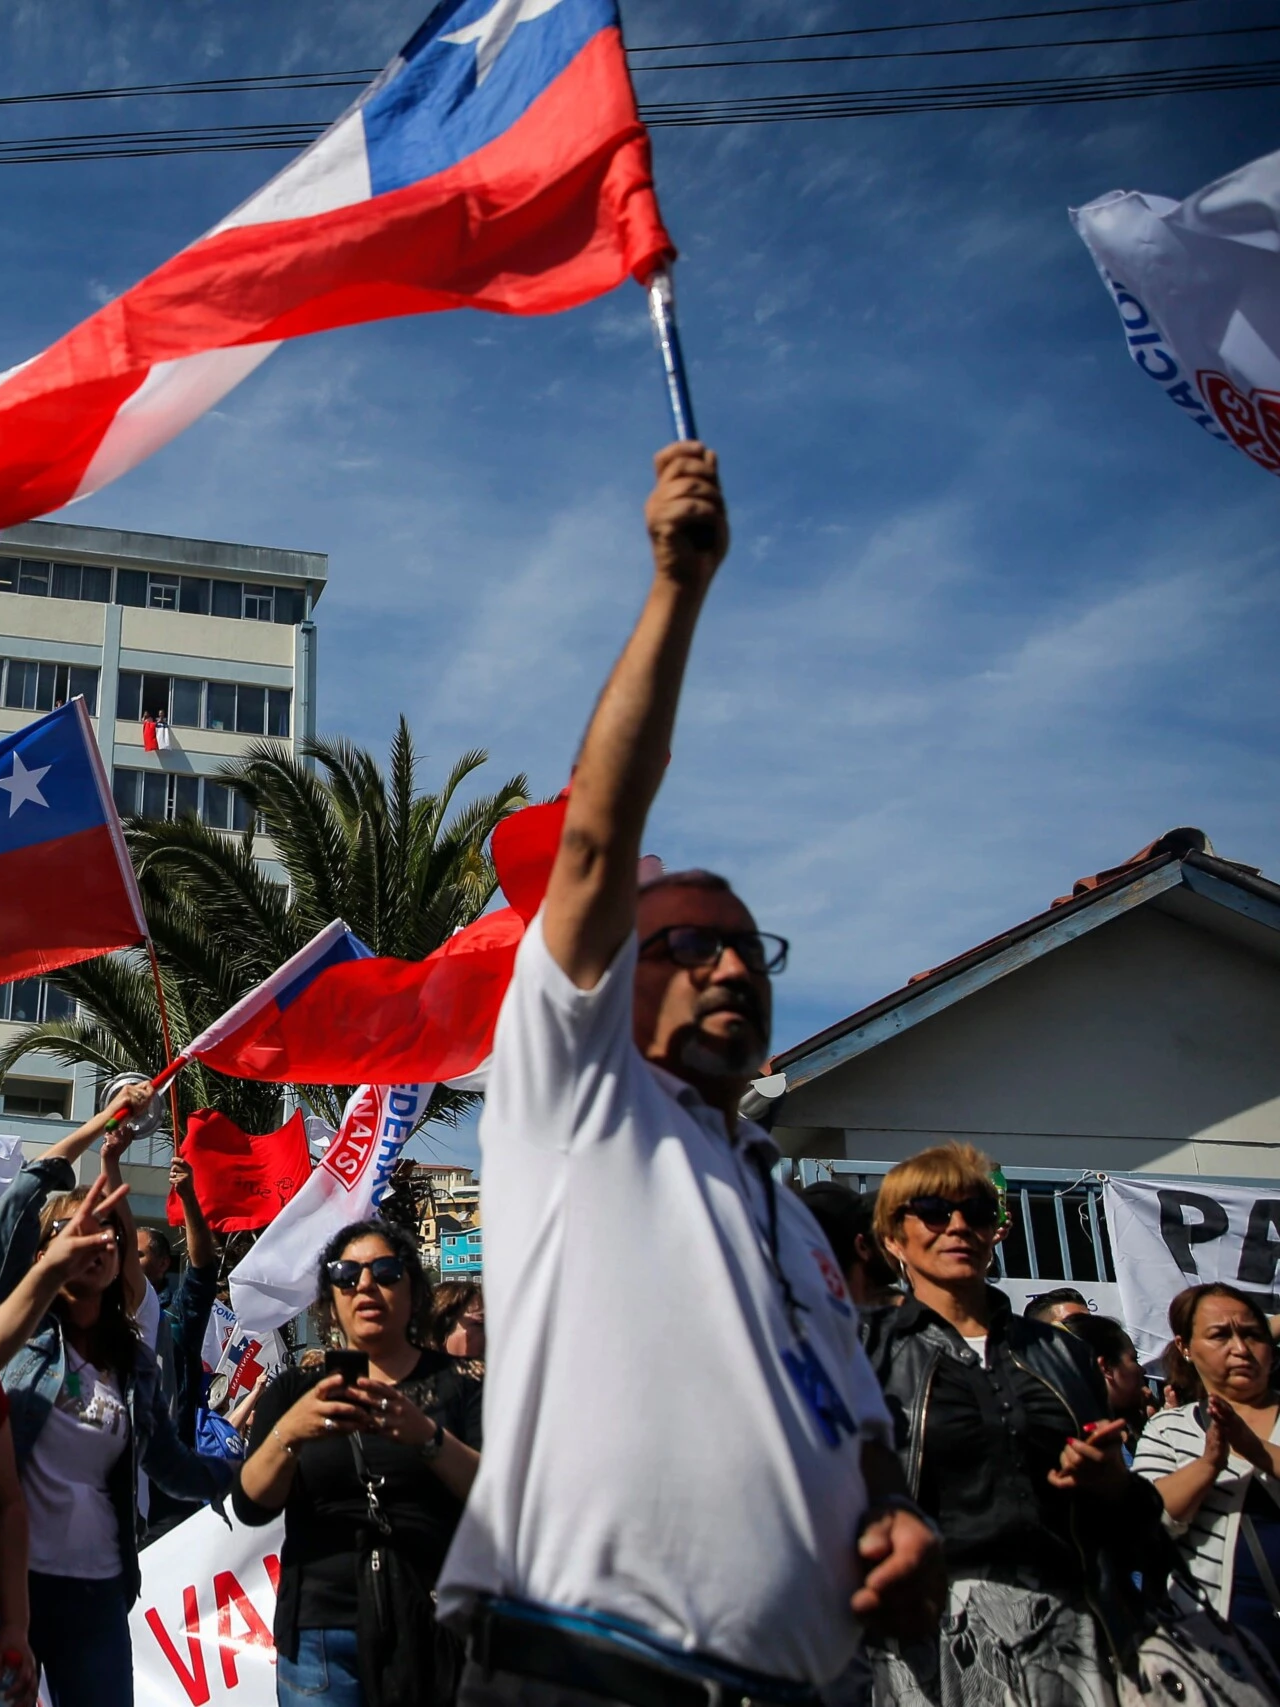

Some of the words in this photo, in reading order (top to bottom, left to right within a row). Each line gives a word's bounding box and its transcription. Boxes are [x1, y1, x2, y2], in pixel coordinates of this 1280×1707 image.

[1220, 388, 1280, 466] ATS
[335, 1095, 376, 1175] NATS
[145, 1554, 280, 1706] VA
